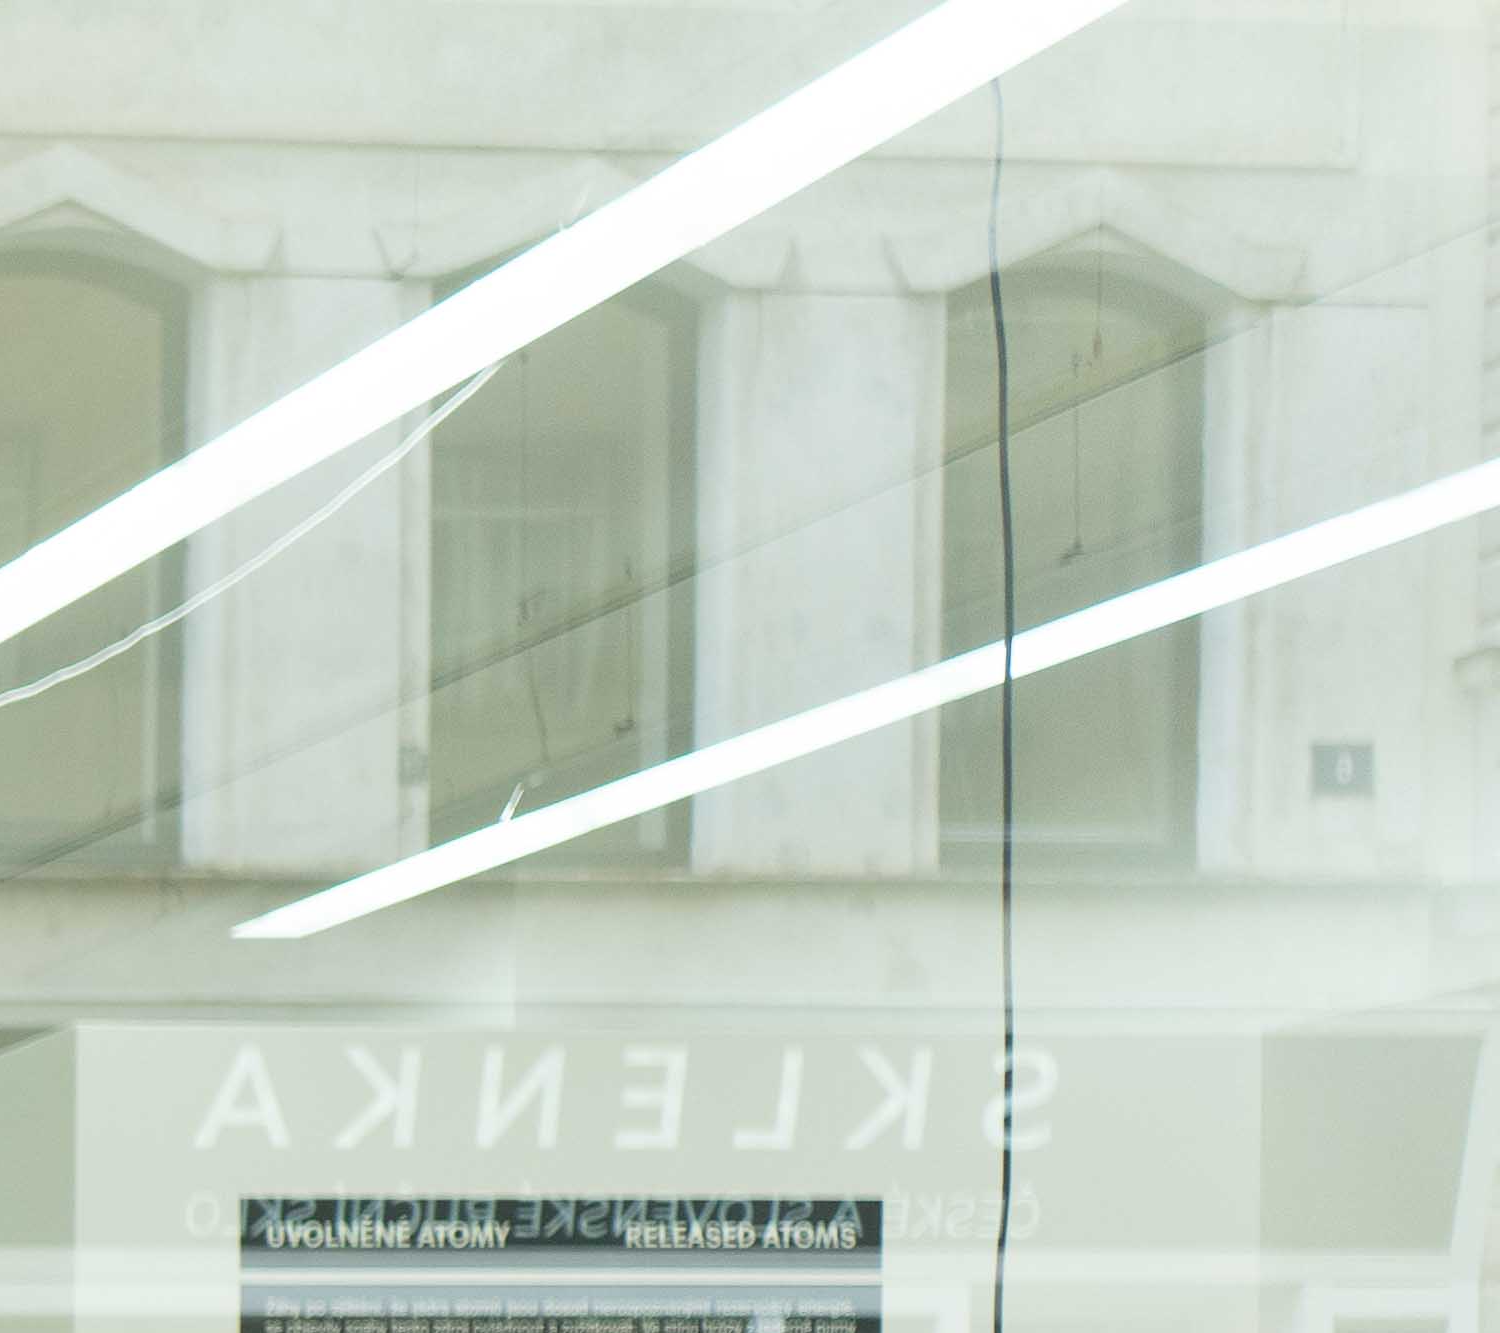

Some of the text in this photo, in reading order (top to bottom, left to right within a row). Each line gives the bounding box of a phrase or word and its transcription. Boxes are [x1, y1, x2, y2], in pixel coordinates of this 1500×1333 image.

[265, 1215, 858, 1249] UVOLNĚNÉ ATOMY RELEASED ATOMS
